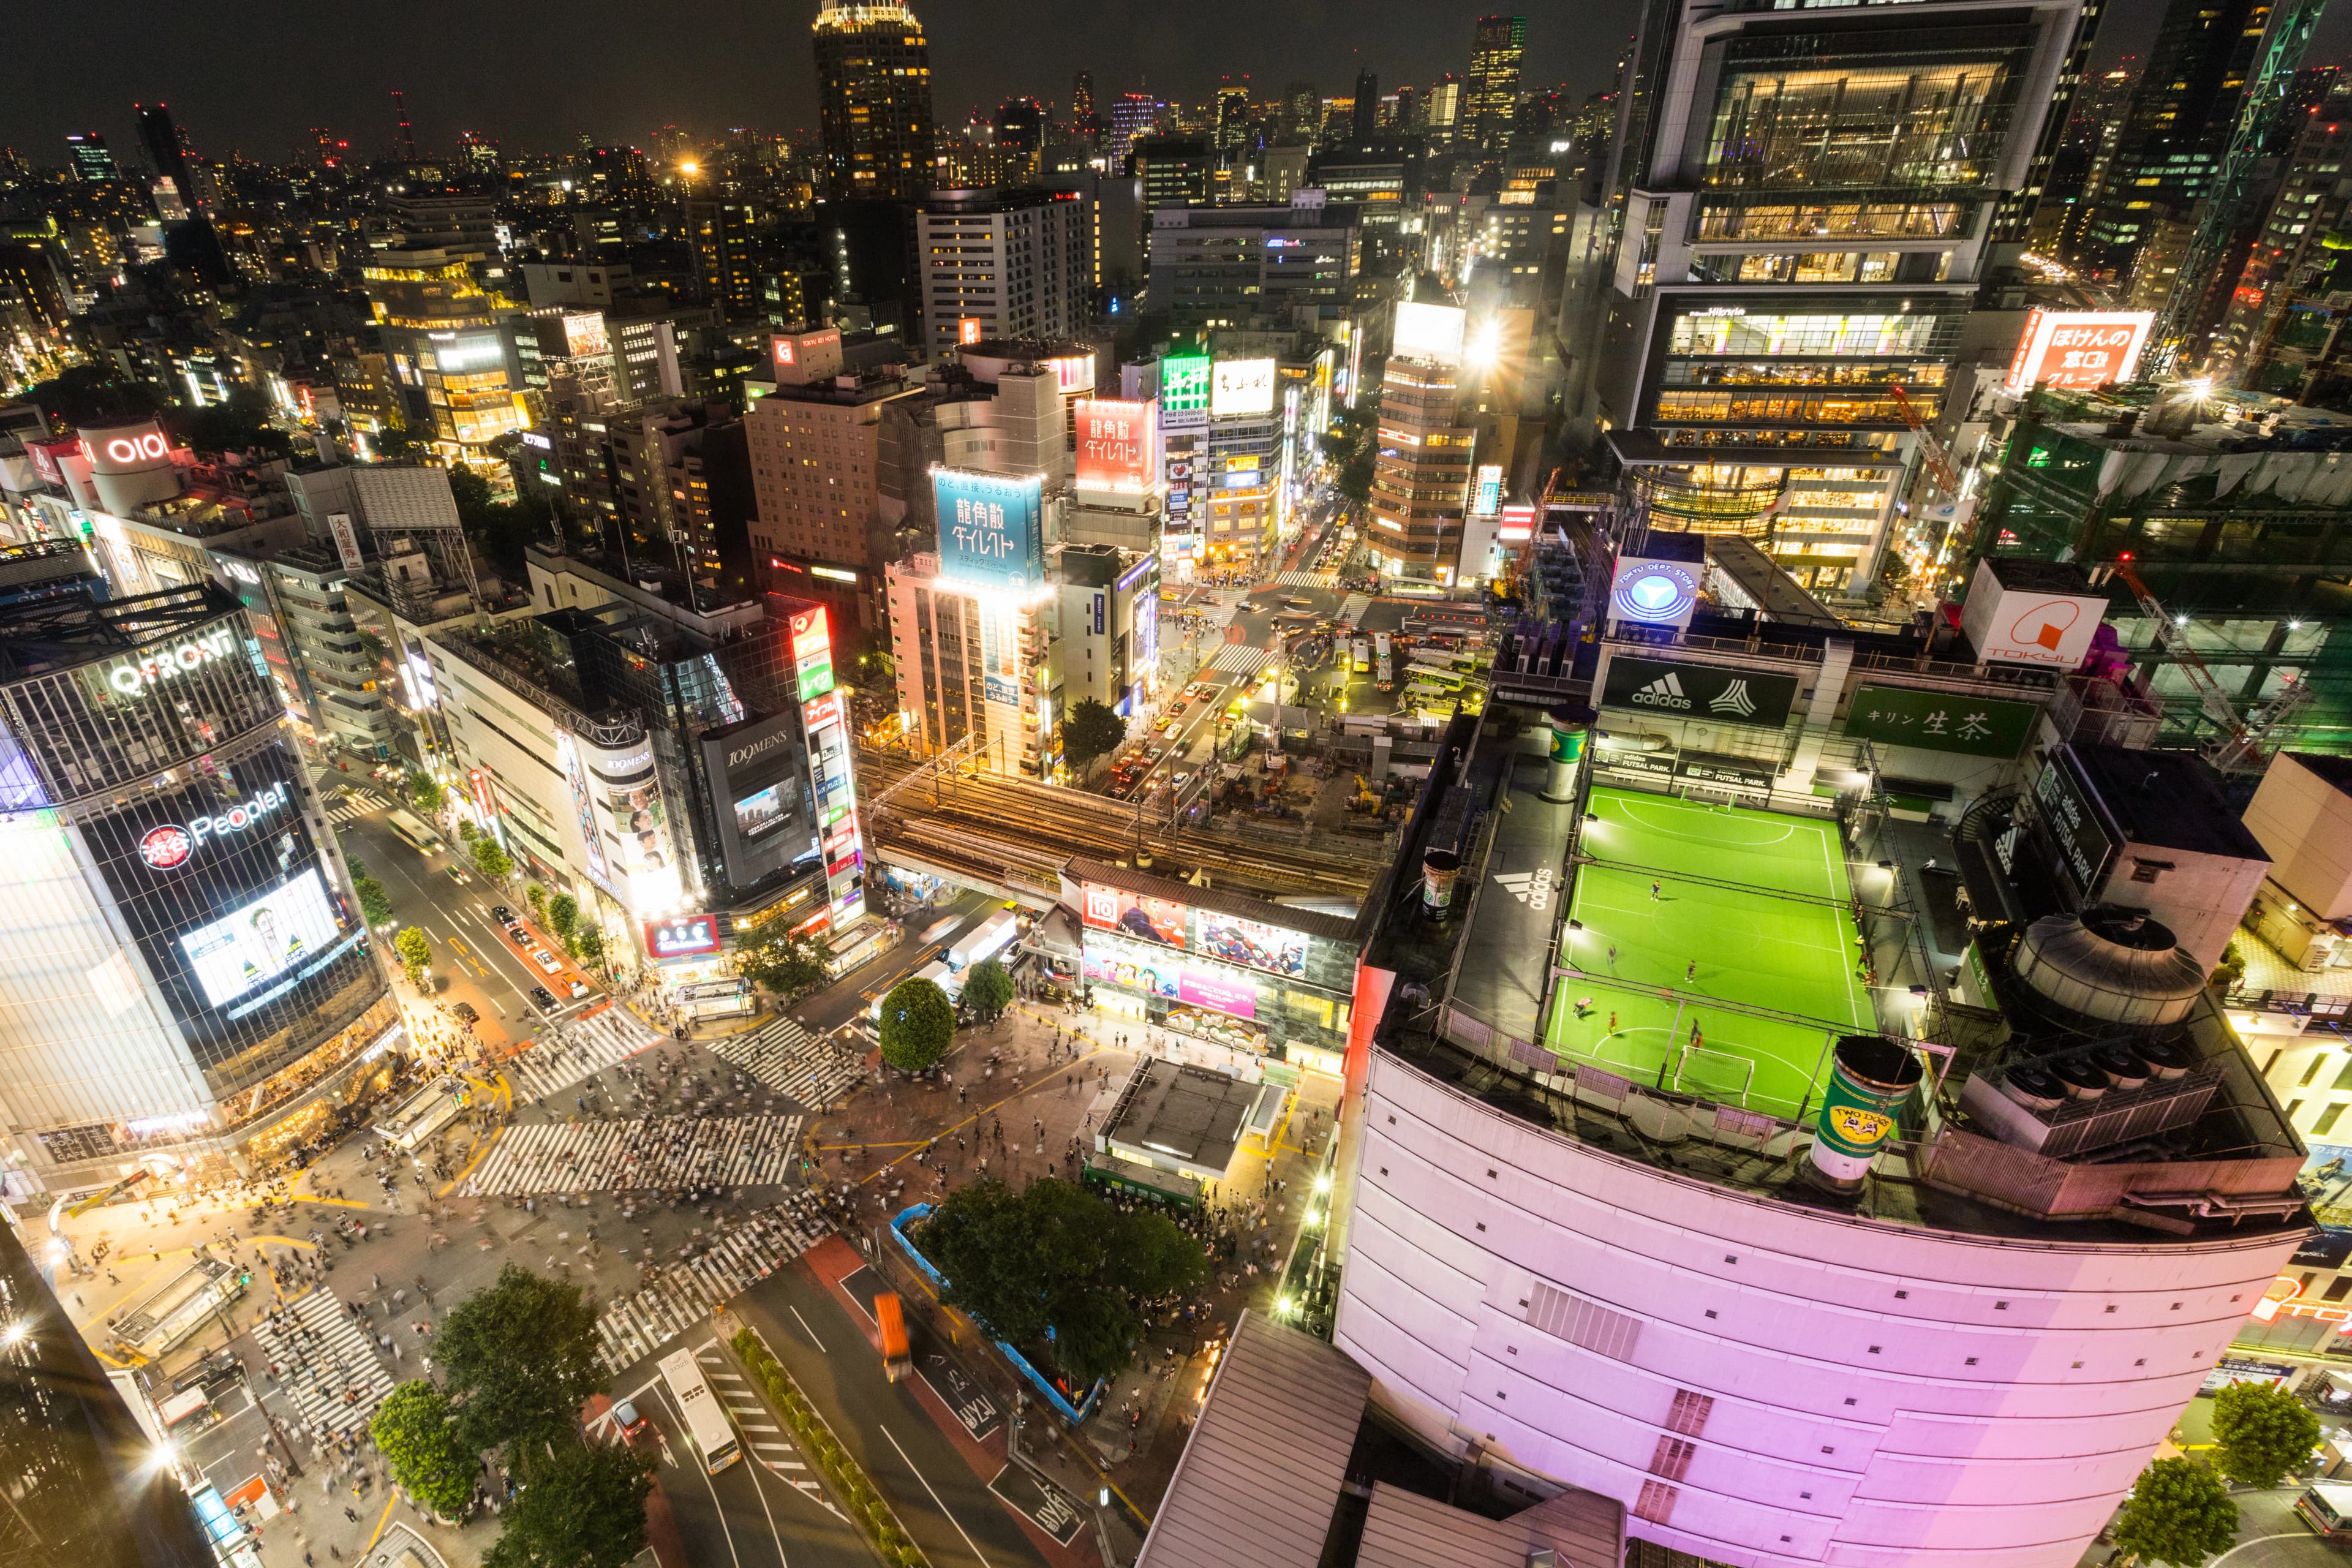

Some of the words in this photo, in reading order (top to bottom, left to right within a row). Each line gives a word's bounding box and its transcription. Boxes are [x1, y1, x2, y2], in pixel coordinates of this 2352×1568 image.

[2052, 330, 2130, 347] ほけんの
[2060, 351, 2101, 368] 窓口
[1221, 374, 1268, 392] ちふれ
[2048, 372, 2108, 385] グループ
[1090, 419, 1129, 440] 龍角散
[1085, 440, 1137, 461] ダイレクト
[938, 478, 1022, 499] のど、直接、うるおう
[956, 497, 1005, 530] 龍角散
[336, 519, 356, 559] 大和証券
[952, 526, 1014, 559] ダイレクト
[1619, 565, 1644, 584] TOKYU
[1674, 568, 1695, 589] STORE
[110, 628, 233, 697] QFRONT
[1986, 647, 2079, 665] TOKYU
[802, 670, 831, 692] レイク
[807, 701, 836, 720] アイフル
[1632, 692, 1692, 710] adidas
[1868, 710, 1915, 725] キリン
[1923, 710, 1992, 741] 生茶
[1623, 760, 1649, 770] FUTSAL
[1649, 764, 1671, 774] PARK.
[1715, 774, 1743, 784] FUTSAL
[1744, 778, 1767, 788] PARK.
[142, 833, 190, 864] 渋谷
[189, 781, 288, 846] People!
[2062, 795, 2081, 829] adidas
[1994, 838, 2012, 876] adidas
[2053, 811, 2076, 856] FUTSAL
[2071, 846, 2092, 888] PARK.
[1529, 868, 1553, 910] adidas
[363, 1025, 404, 1063] TSUTAYA
[1835, 1109, 1861, 1118] TWO
[1863, 1110, 1890, 1127] DOGS
